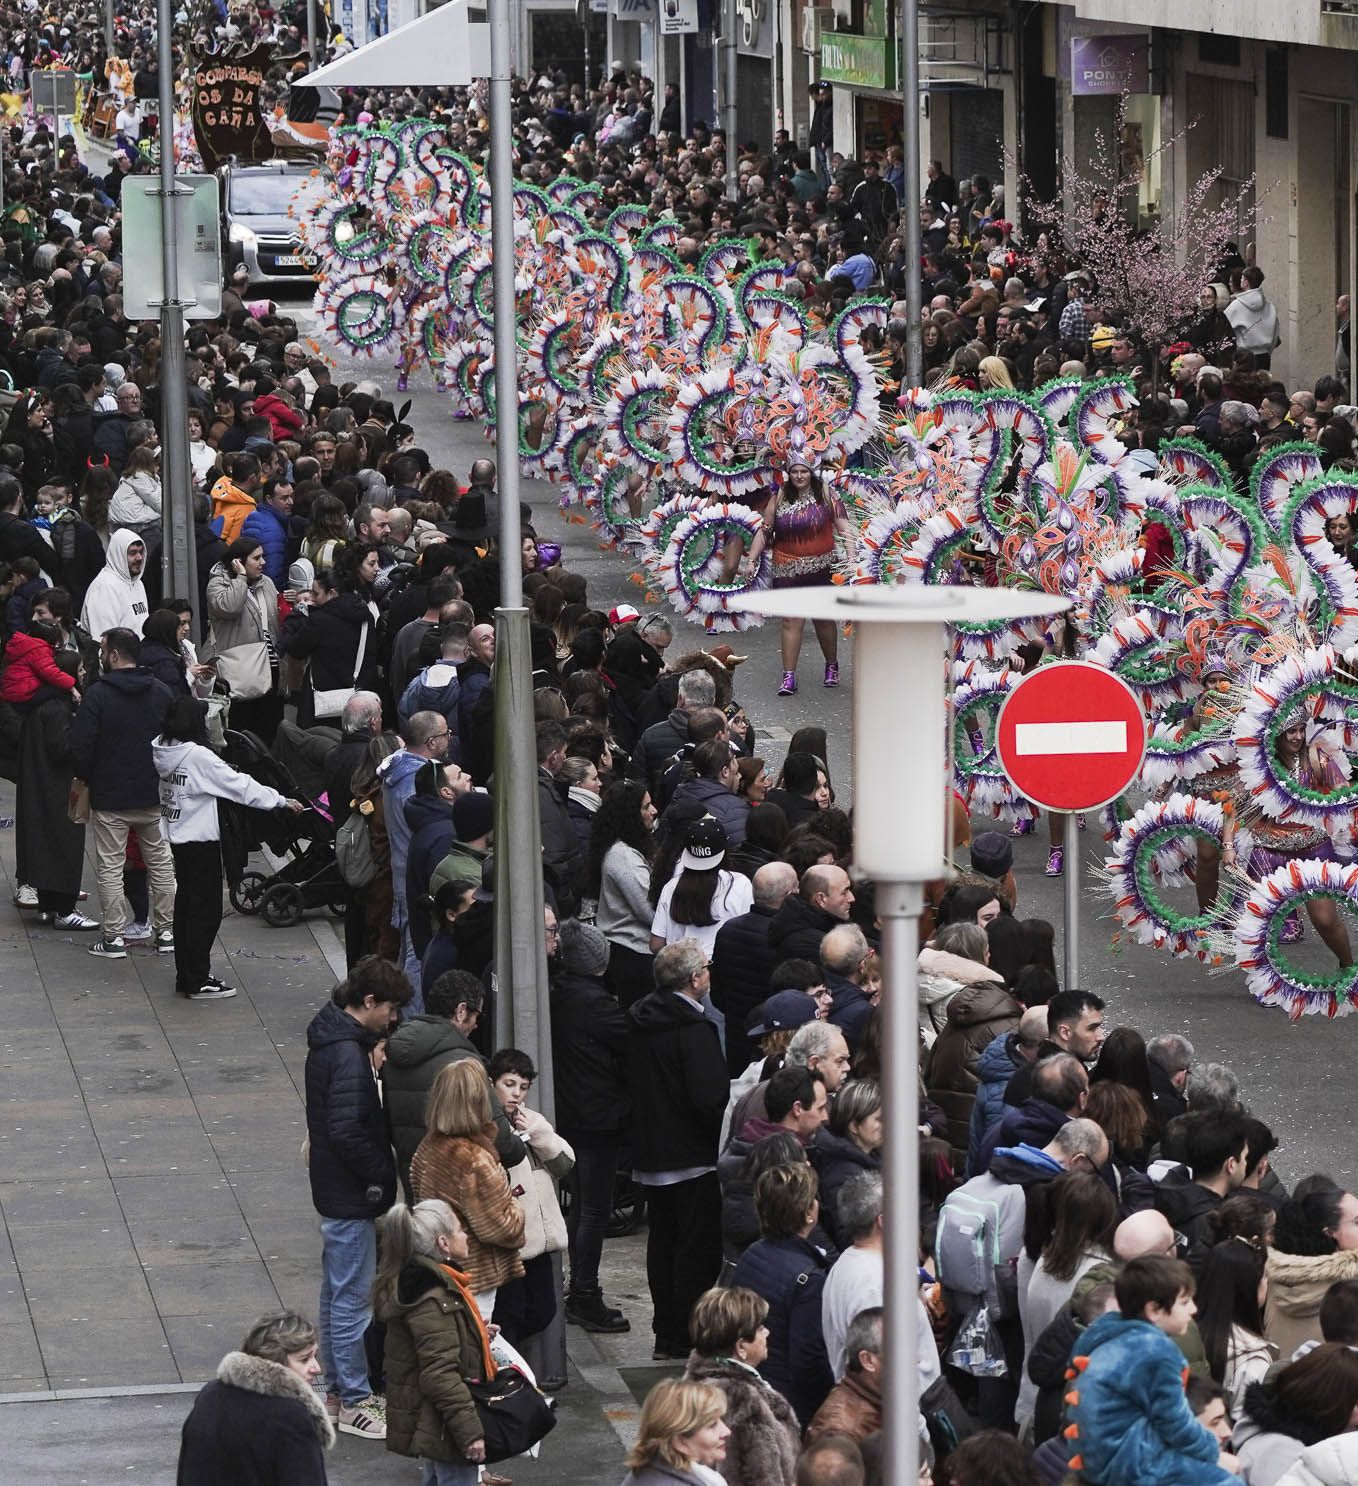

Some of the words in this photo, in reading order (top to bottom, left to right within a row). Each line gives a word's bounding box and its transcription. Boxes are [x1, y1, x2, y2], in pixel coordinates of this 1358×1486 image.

[199, 88, 222, 106] OS
[232, 87, 254, 105] DA
[205, 107, 256, 128] CAÑA
[691, 845, 712, 857] KING
